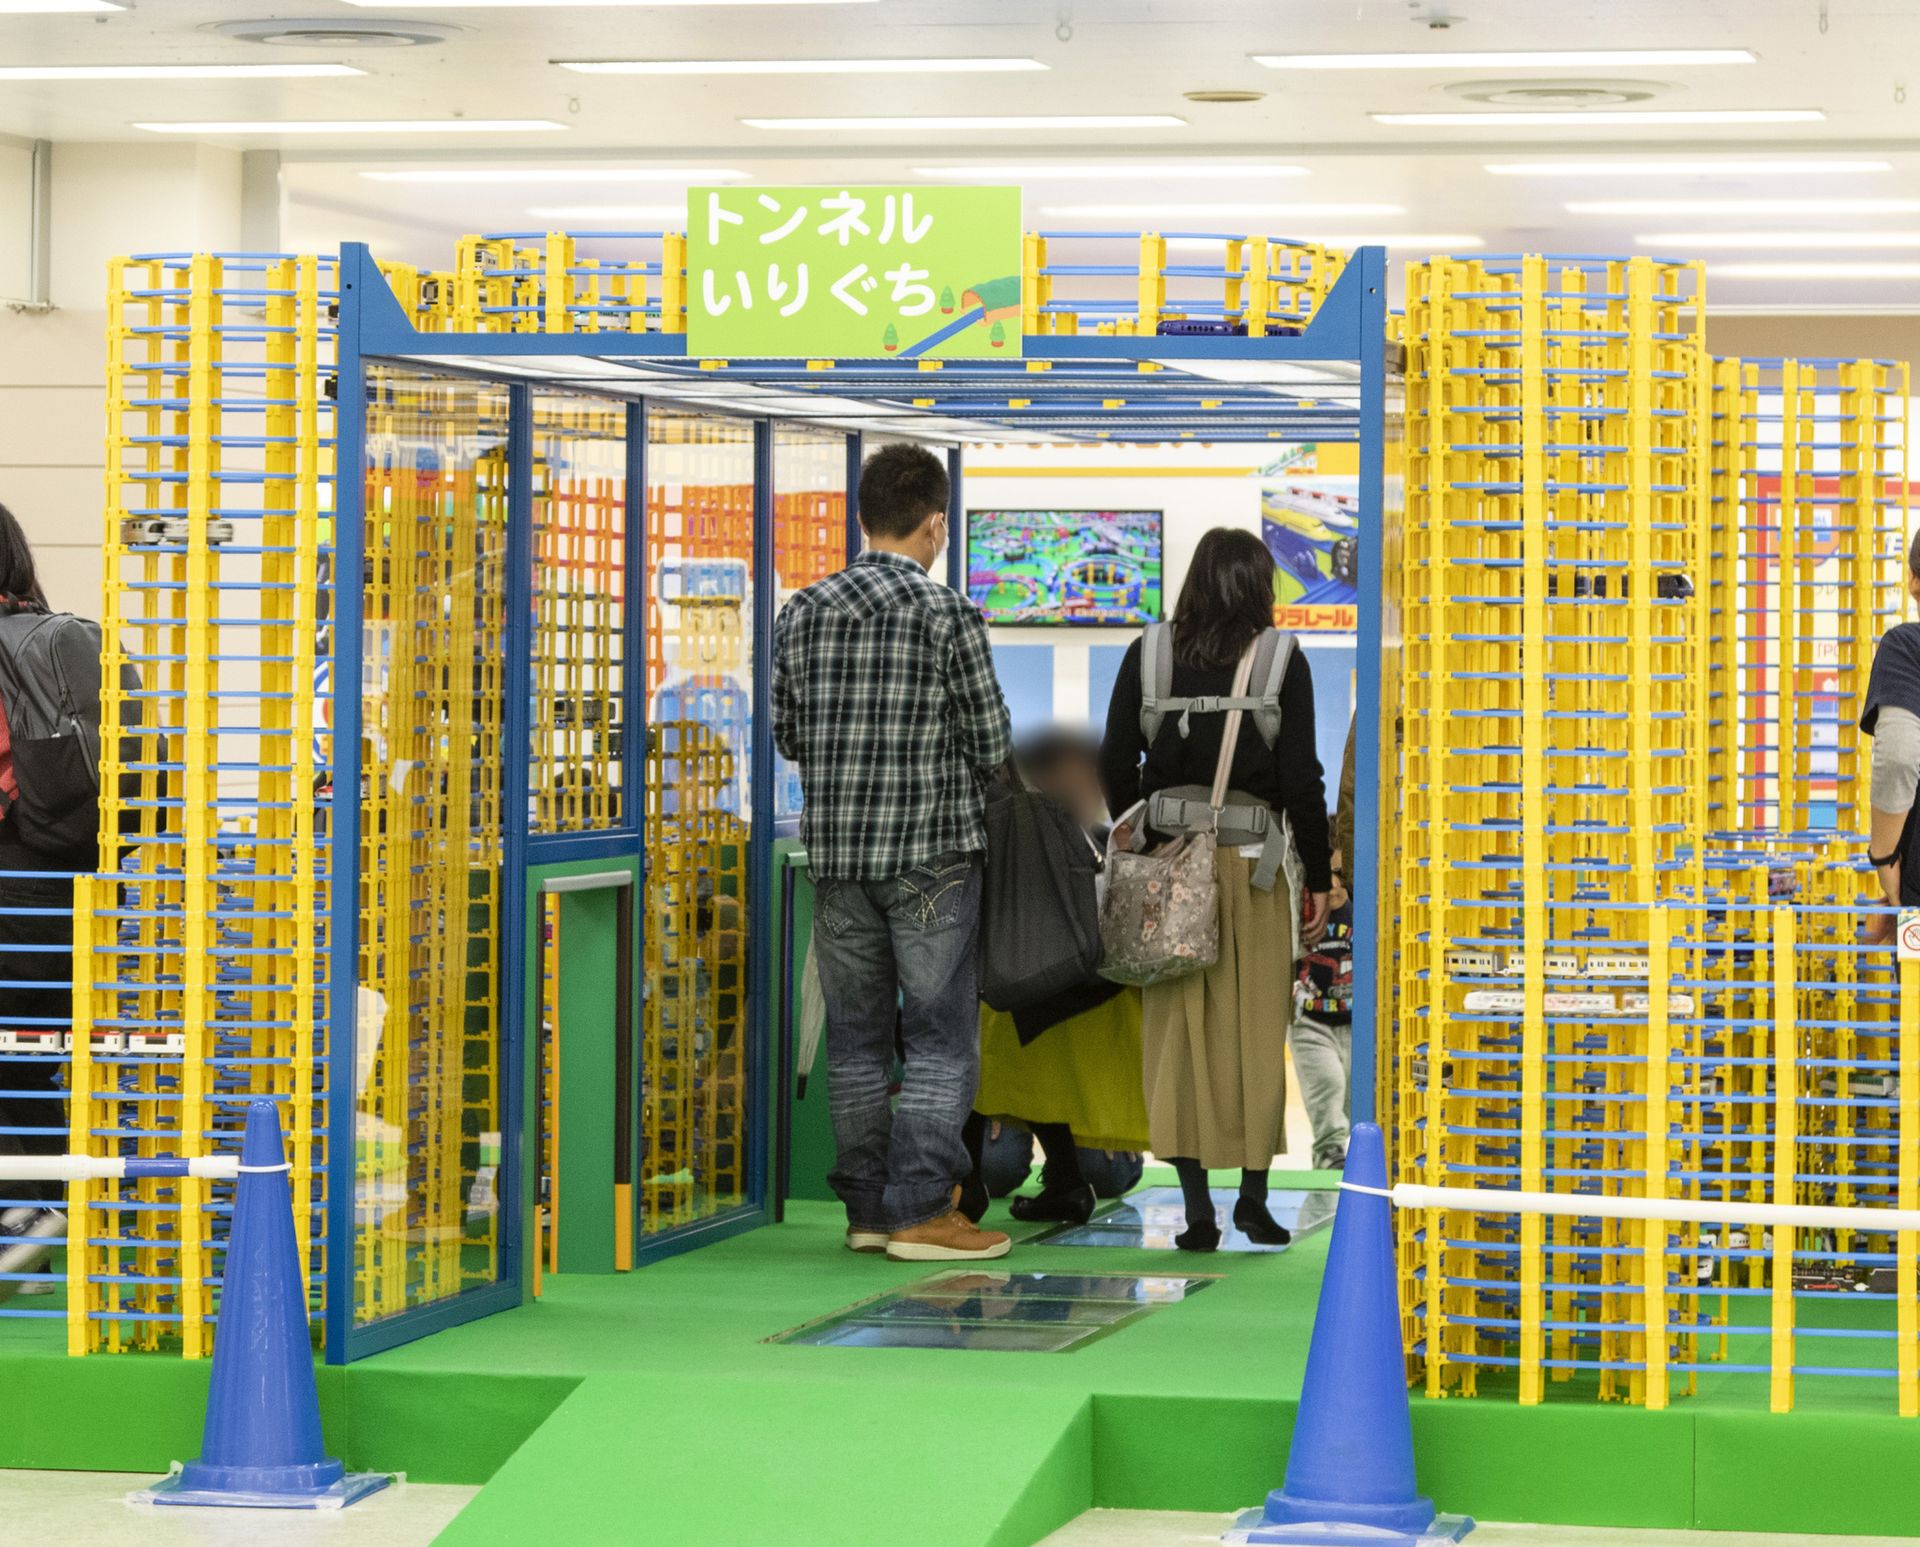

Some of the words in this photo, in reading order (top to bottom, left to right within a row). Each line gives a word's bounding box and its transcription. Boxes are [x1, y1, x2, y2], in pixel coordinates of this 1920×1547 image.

[708, 190, 933, 246] トンネル
[703, 262, 936, 317] いりぐち
